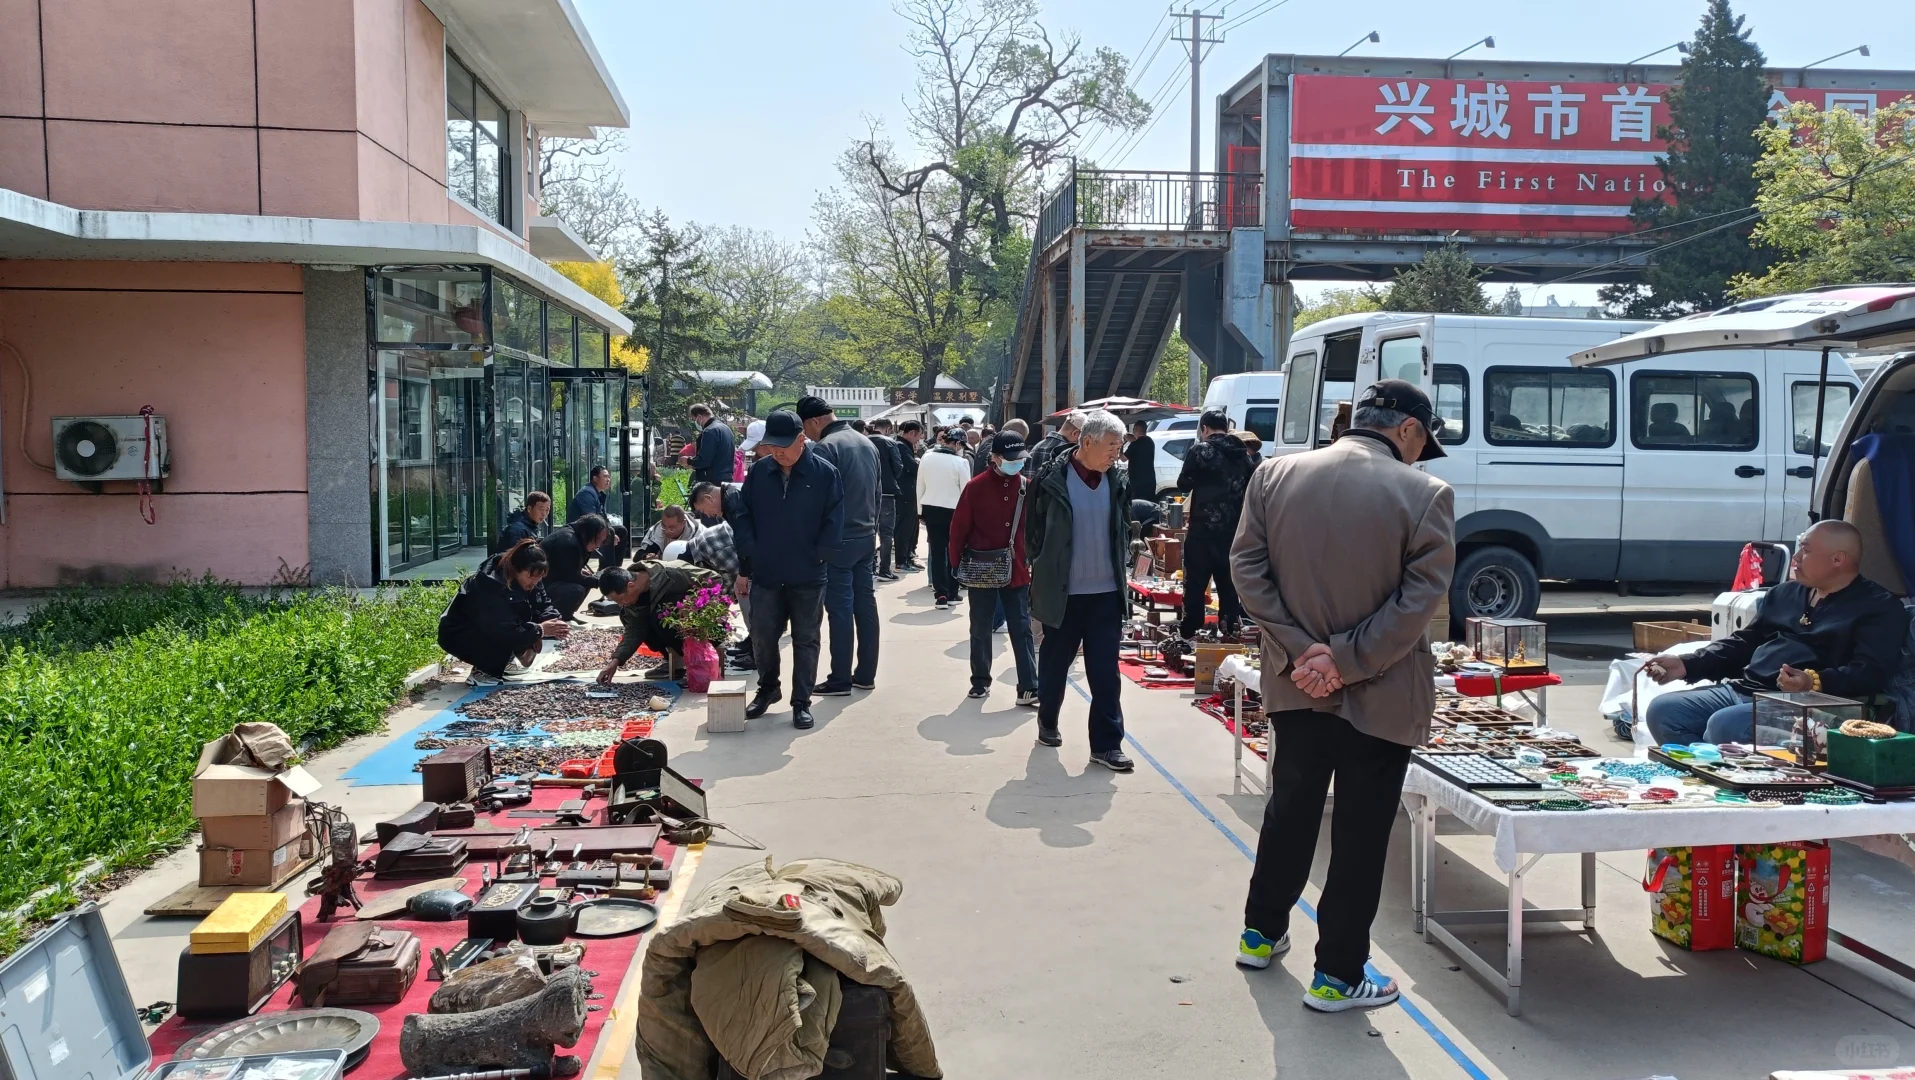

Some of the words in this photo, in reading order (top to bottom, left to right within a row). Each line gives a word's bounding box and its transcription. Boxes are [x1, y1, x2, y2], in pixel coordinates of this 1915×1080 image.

[1396, 168, 1456, 189] The
[1477, 170, 1556, 191] First
[894, 390, 979, 402] 张学温泉别墅
